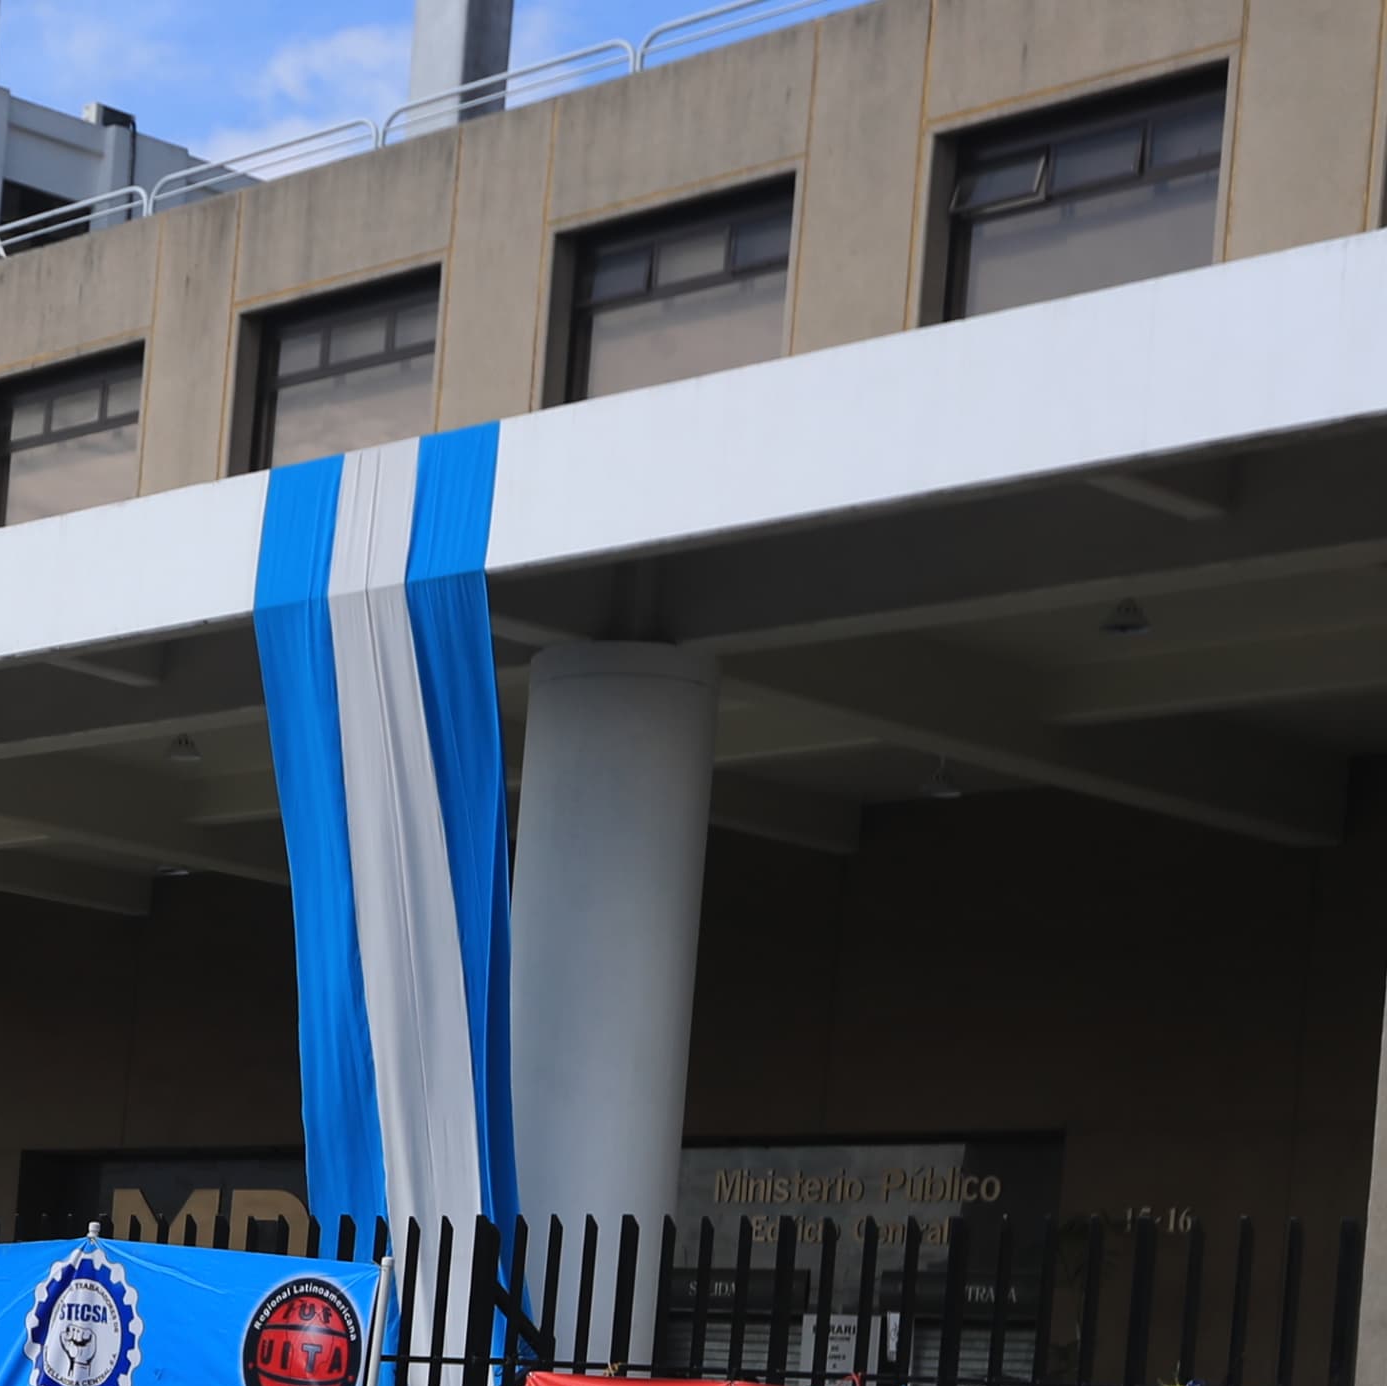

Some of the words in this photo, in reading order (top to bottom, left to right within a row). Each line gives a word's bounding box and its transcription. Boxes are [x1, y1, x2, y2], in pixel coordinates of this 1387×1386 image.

[714, 1168, 866, 1204] Ministerio
[882, 1166, 1003, 1203] Público
[59, 1302, 108, 1325] STECSA
[253, 1287, 291, 1332] Regional
[292, 1281, 358, 1343] Latinoamericana
[260, 1339, 343, 1374] UITA
